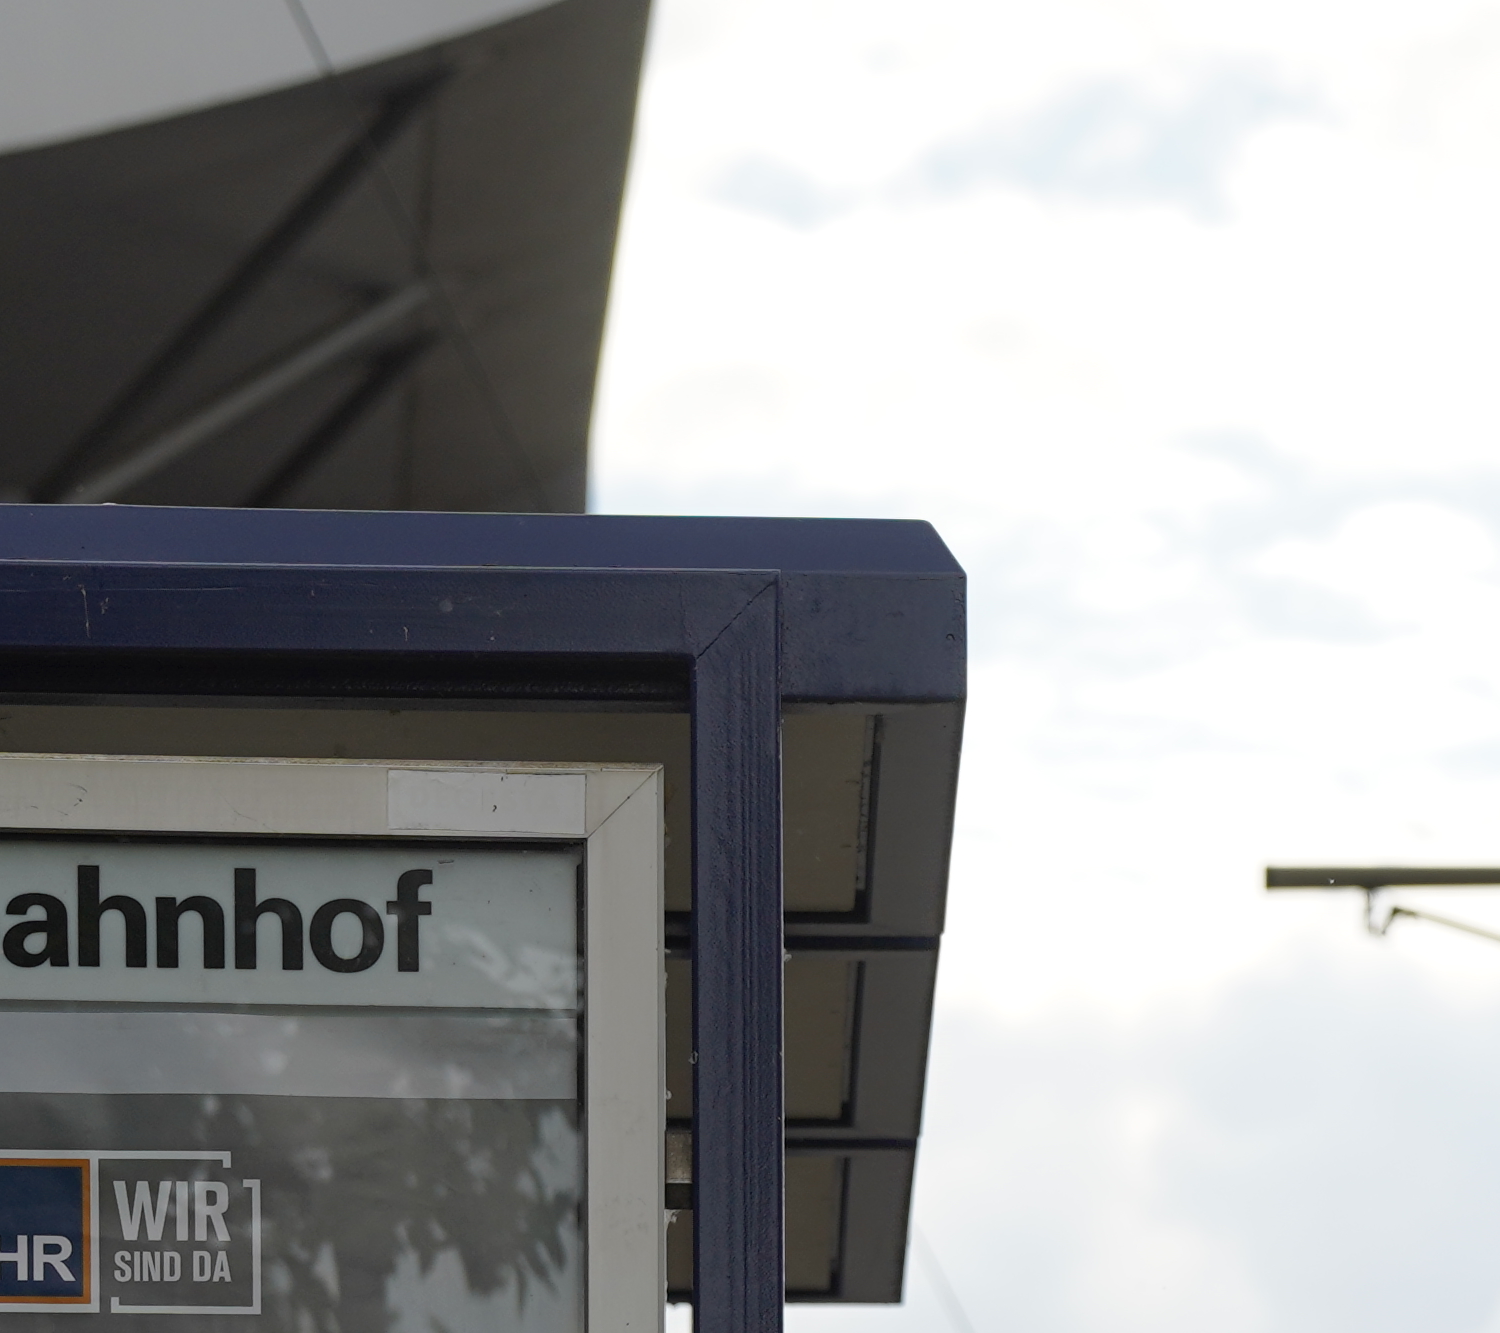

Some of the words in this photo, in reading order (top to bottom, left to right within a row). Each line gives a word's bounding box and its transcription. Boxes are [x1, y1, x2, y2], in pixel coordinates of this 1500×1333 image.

[112, 1179, 231, 1243] WIR
[113, 1250, 182, 1283] SIND
[192, 1250, 232, 1283] DA
